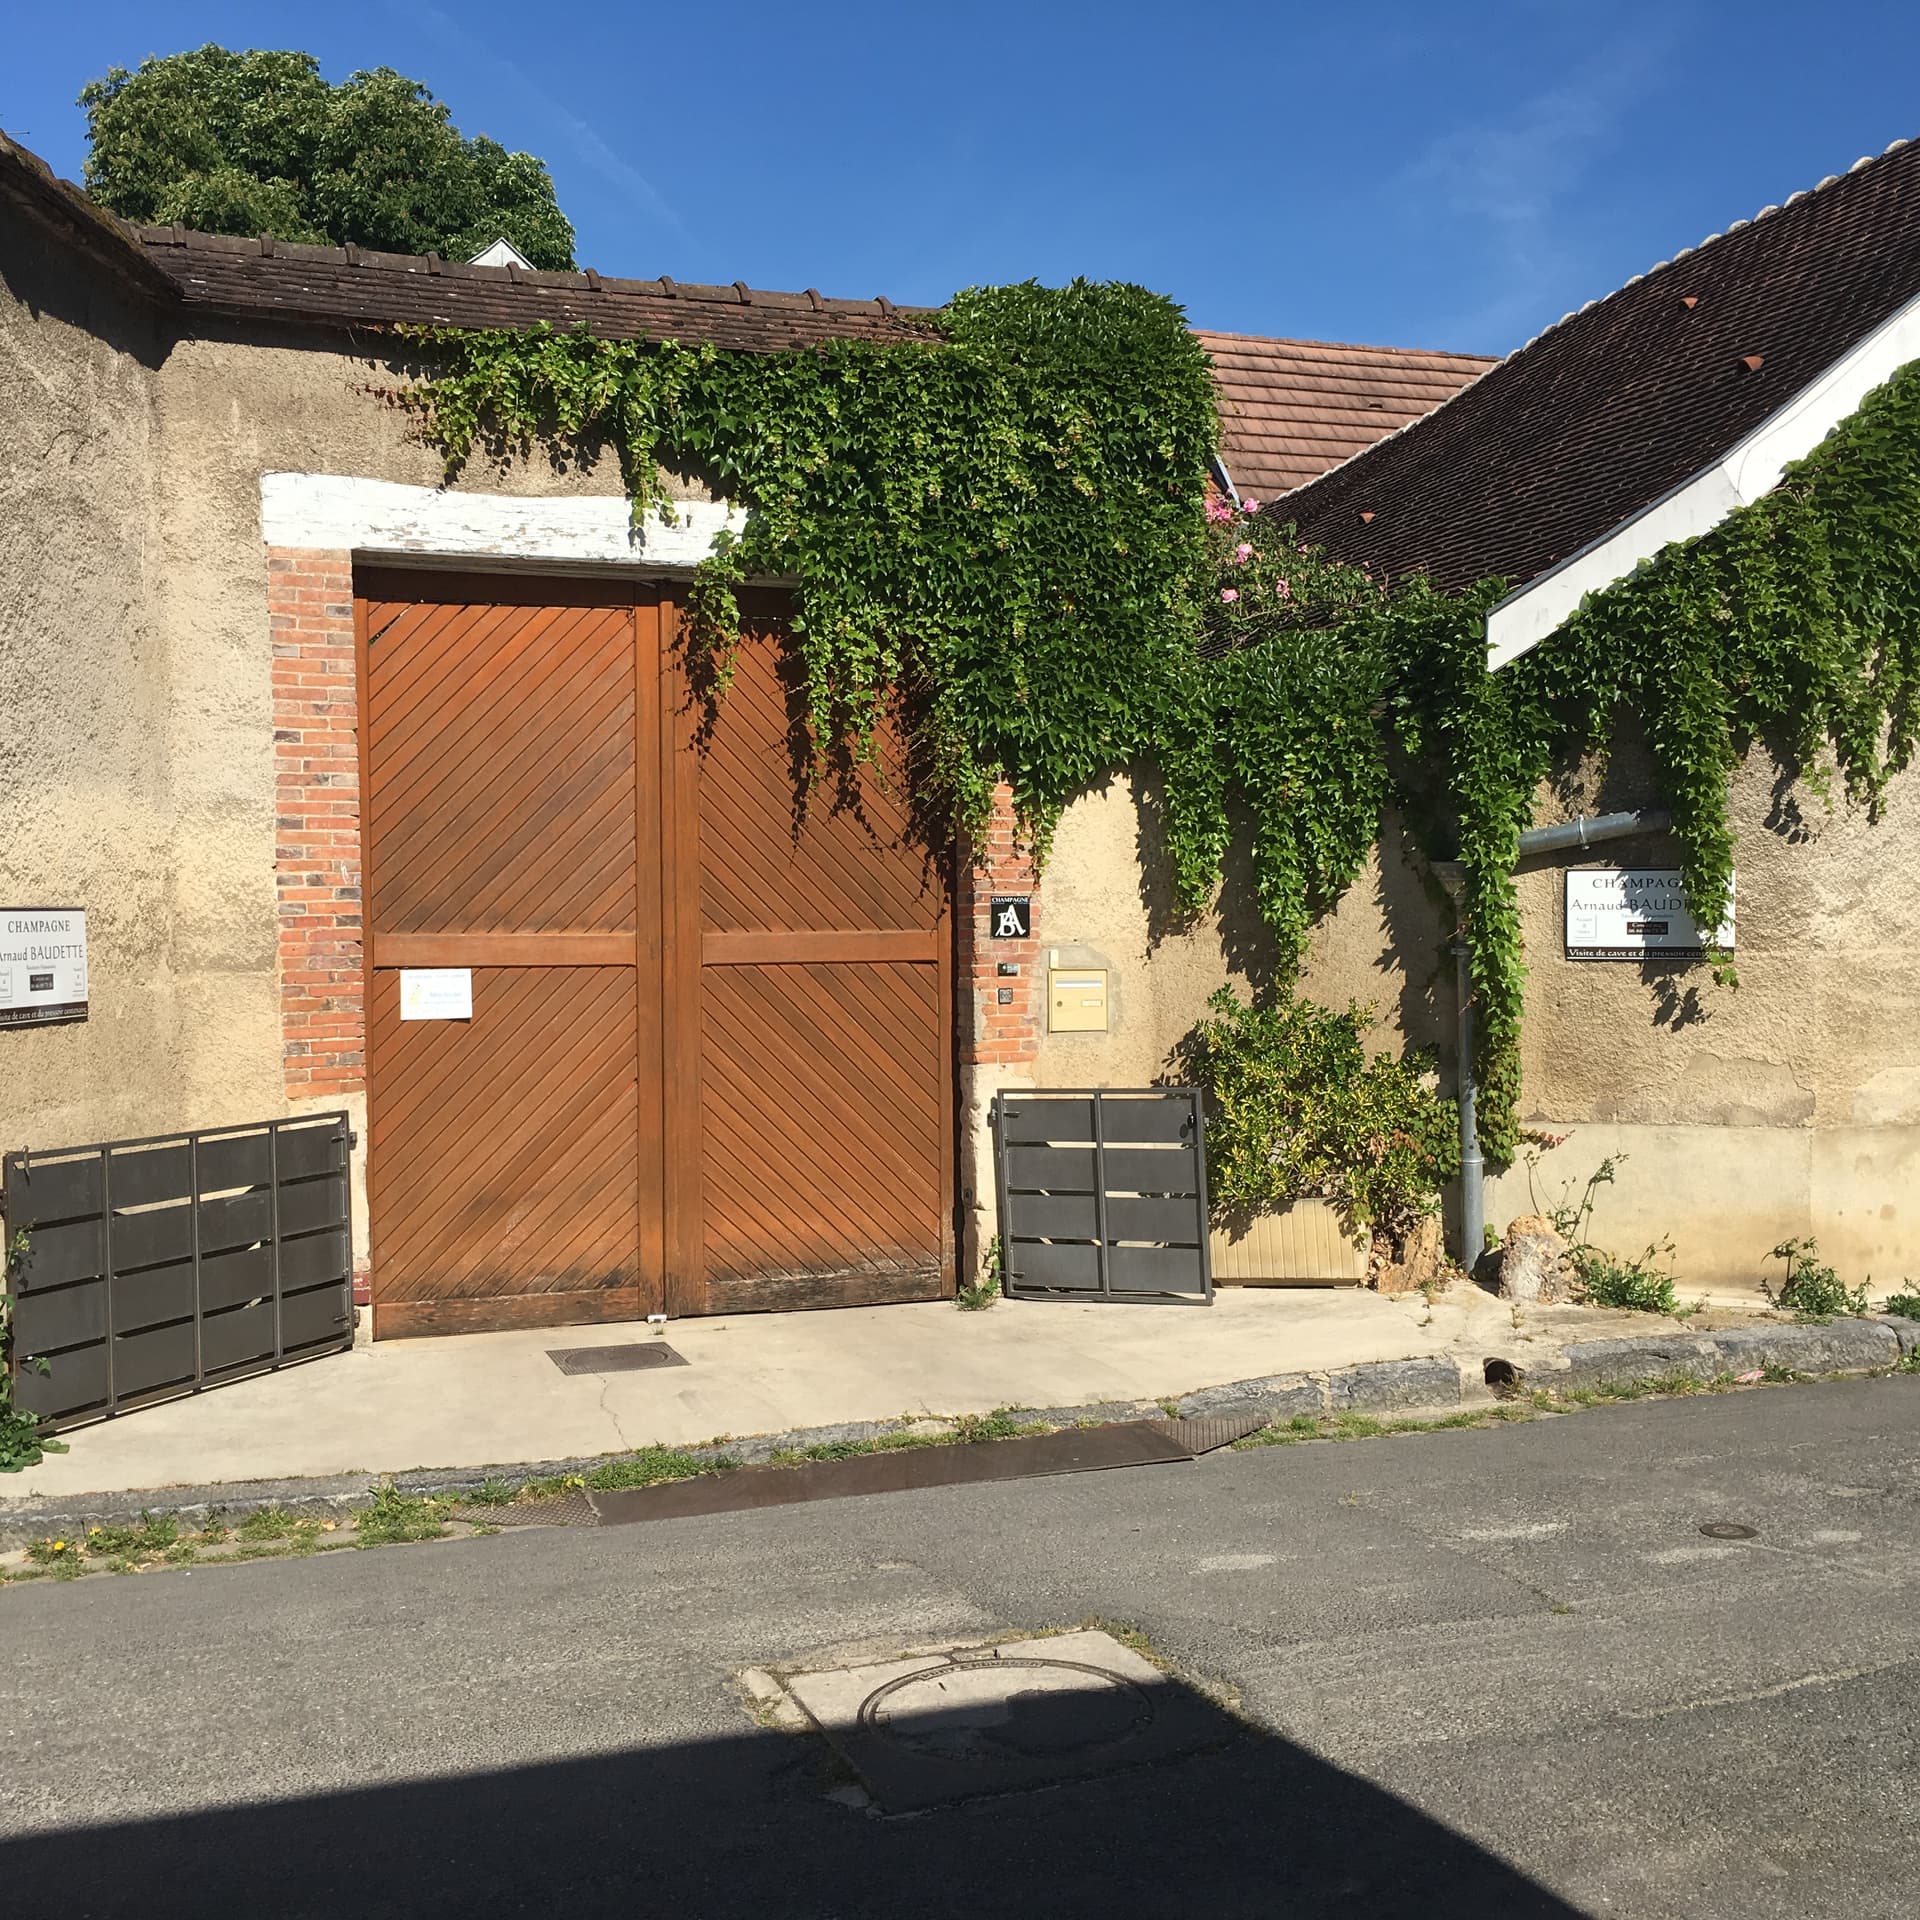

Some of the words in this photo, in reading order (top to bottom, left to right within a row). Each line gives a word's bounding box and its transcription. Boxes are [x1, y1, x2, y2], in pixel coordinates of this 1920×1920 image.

[1592, 878, 1681, 889] CHAMPAG
[1570, 898, 1623, 911] Arnaud
[1629, 898, 1690, 911] BAUD
[8, 920, 71, 933] CHAMPAGNE
[31, 945, 83, 960] BAUDETTE
[1569, 948, 1594, 957] Visite
[1596, 948, 1607, 957] de
[1639, 948, 1651, 957] du
